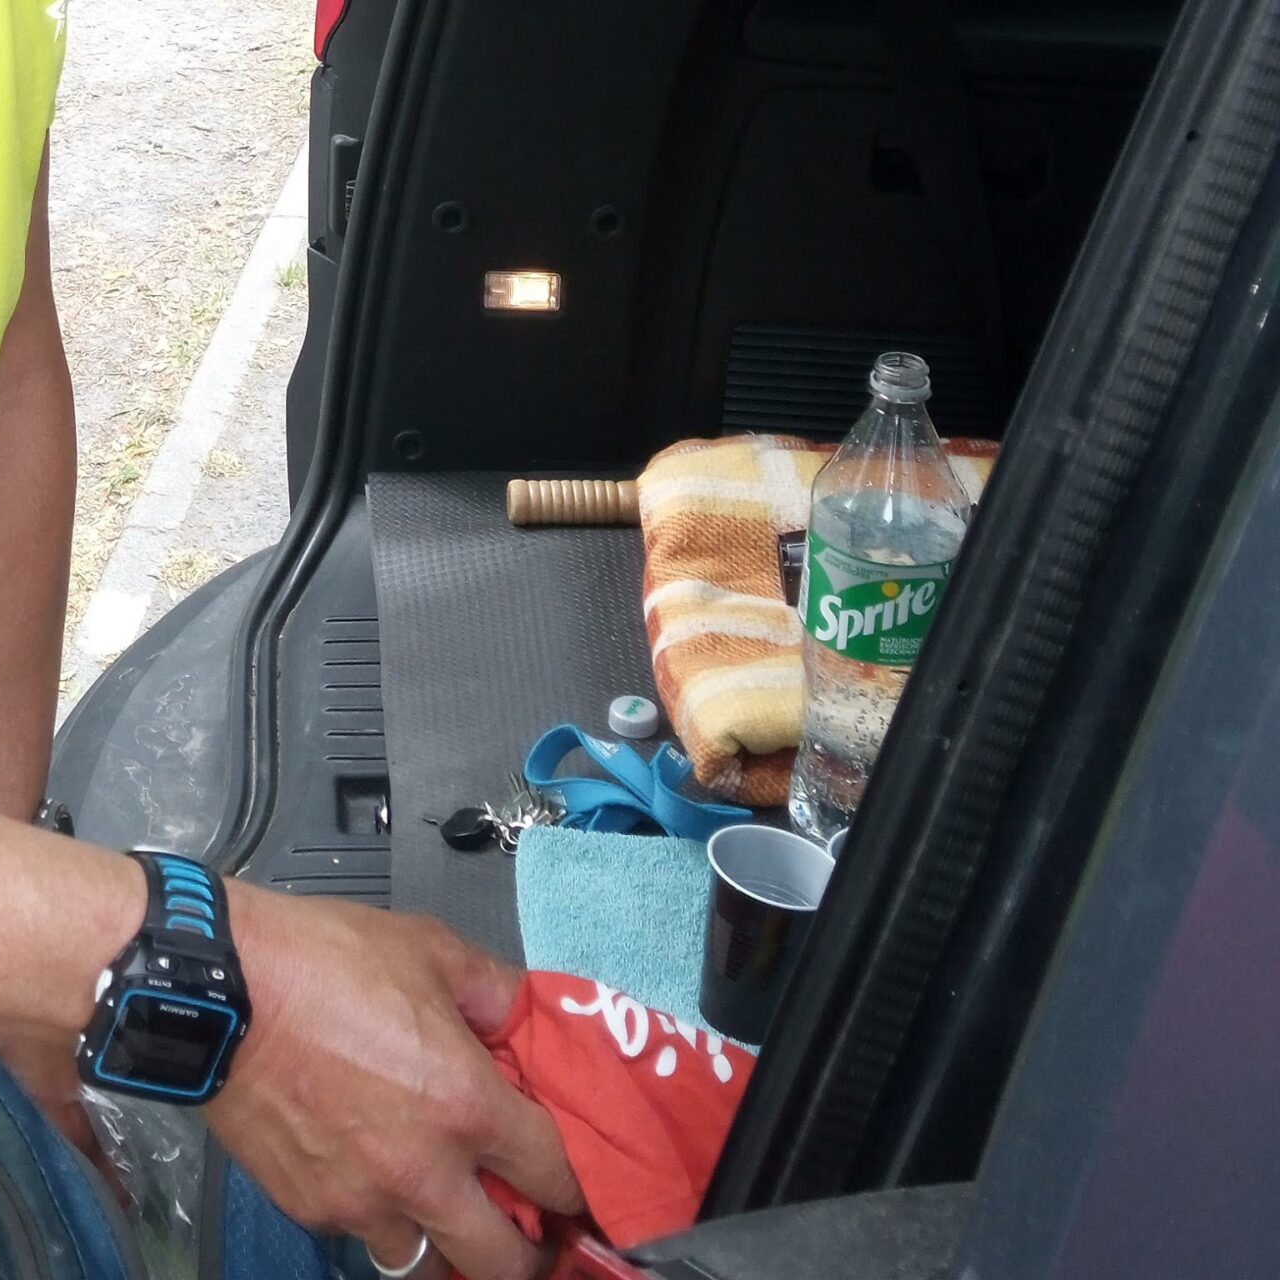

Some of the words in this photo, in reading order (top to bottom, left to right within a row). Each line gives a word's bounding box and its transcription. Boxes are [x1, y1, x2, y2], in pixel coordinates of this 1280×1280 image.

[815, 581, 936, 651] Sprite
[148, 978, 172, 988] ENTER
[160, 1004, 200, 1018] GARMIN
